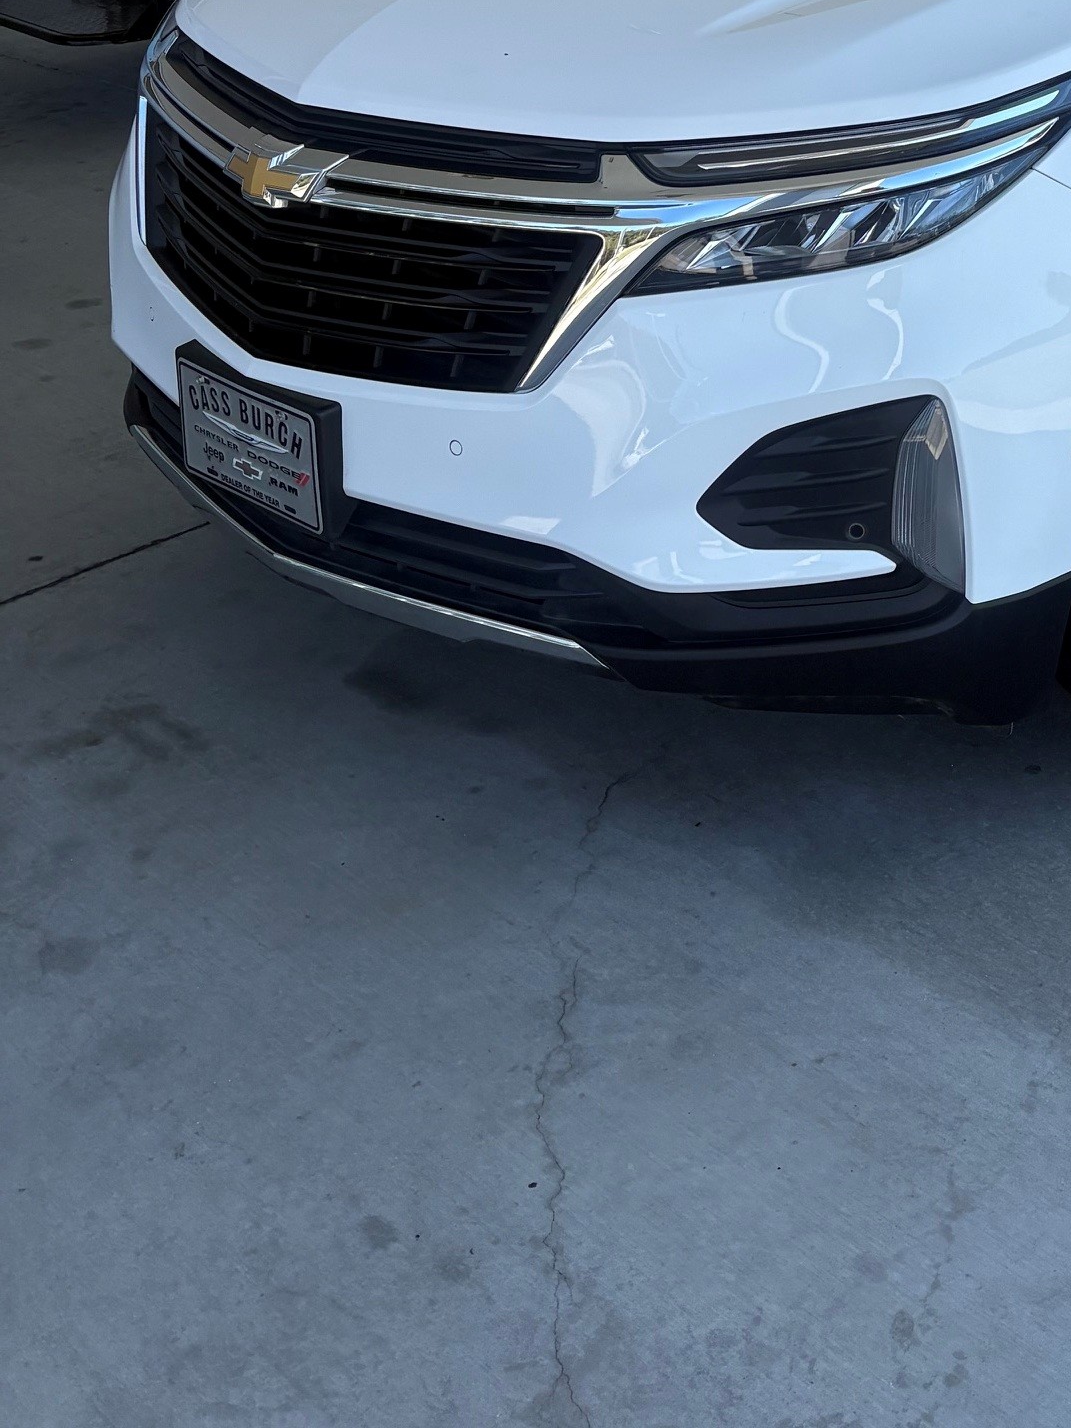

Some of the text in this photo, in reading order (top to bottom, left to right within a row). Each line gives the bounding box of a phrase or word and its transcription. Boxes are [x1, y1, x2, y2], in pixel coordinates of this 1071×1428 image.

[189, 384, 302, 460] CASS BURCH
[194, 424, 239, 452] CHRYSLER
[203, 442, 224, 463] Jeep
[247, 450, 303, 481] DODGE
[221, 474, 243, 490] DEALER
[264, 493, 280, 507] YEAR
[269, 476, 299, 497] RAM
